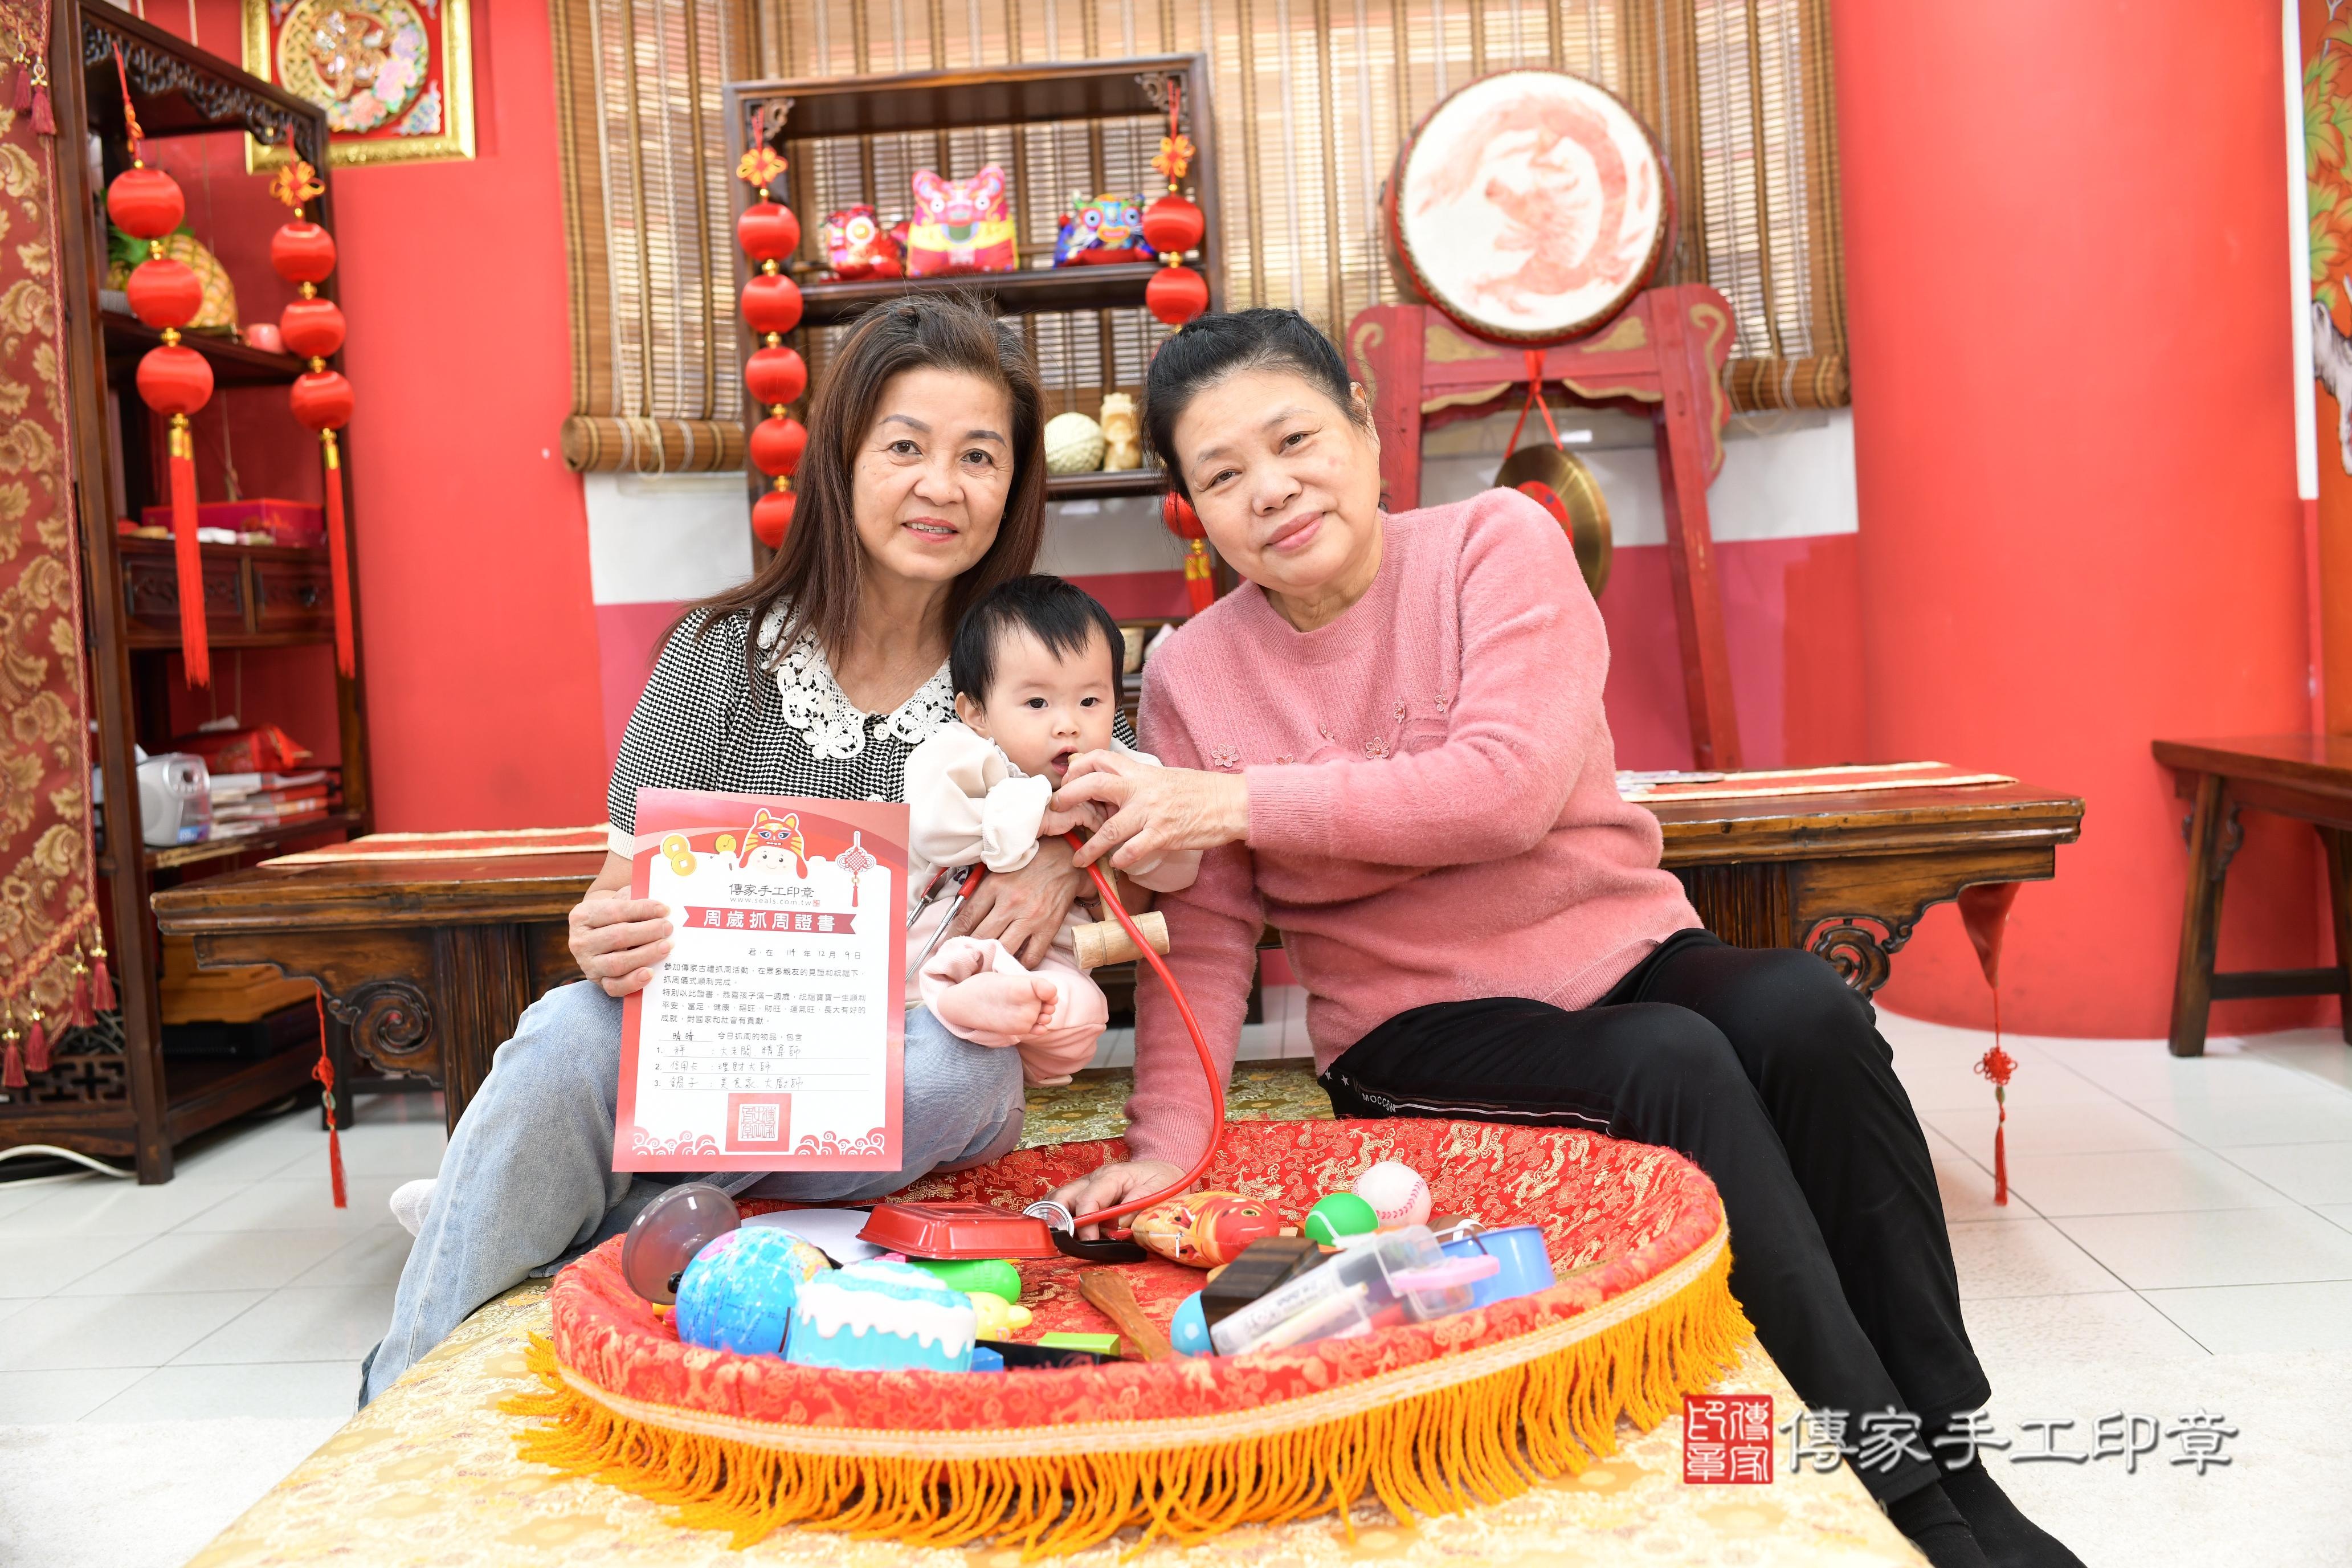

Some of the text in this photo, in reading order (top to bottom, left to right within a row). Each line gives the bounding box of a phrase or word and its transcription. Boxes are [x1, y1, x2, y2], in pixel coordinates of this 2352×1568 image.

[729, 884, 814, 899] 傳家手工印章
[730, 897, 811, 906] www.seals.com.tw
[703, 909, 835, 932] 周歲抓周證書
[844, 951, 850, 960] 9
